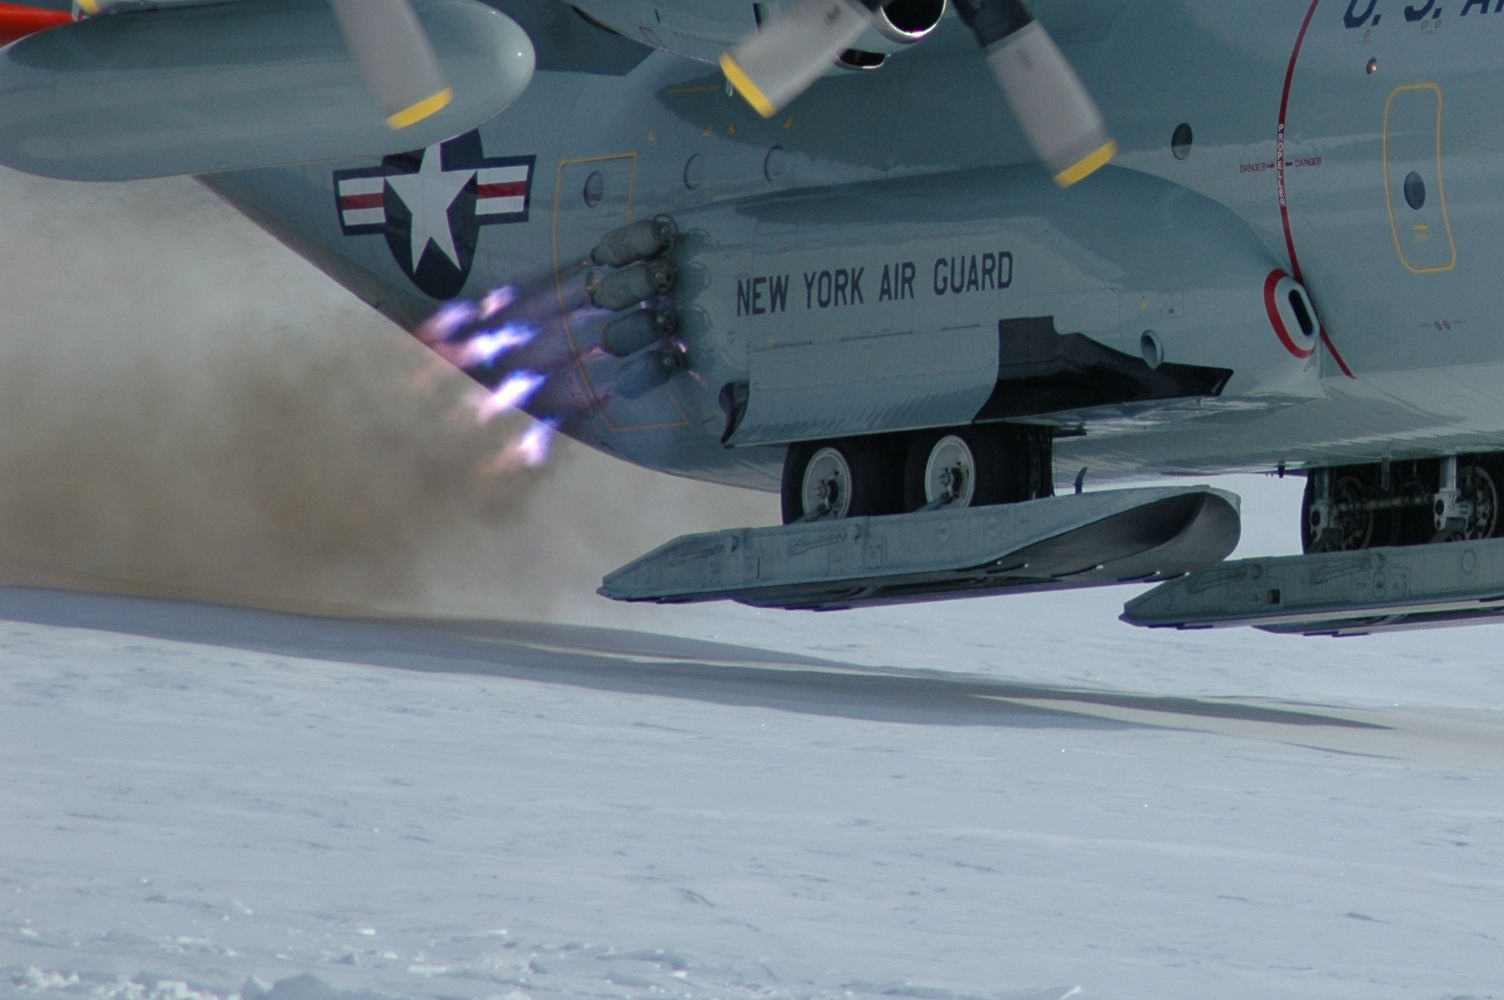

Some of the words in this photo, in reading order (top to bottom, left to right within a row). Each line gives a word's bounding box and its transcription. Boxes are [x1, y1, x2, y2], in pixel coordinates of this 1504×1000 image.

[1277, 123, 1286, 207] PROPELLER
[737, 273, 790, 317] NEW
[803, 266, 865, 310] YORK
[878, 261, 916, 302] AIR
[933, 250, 1014, 296] GUARD
